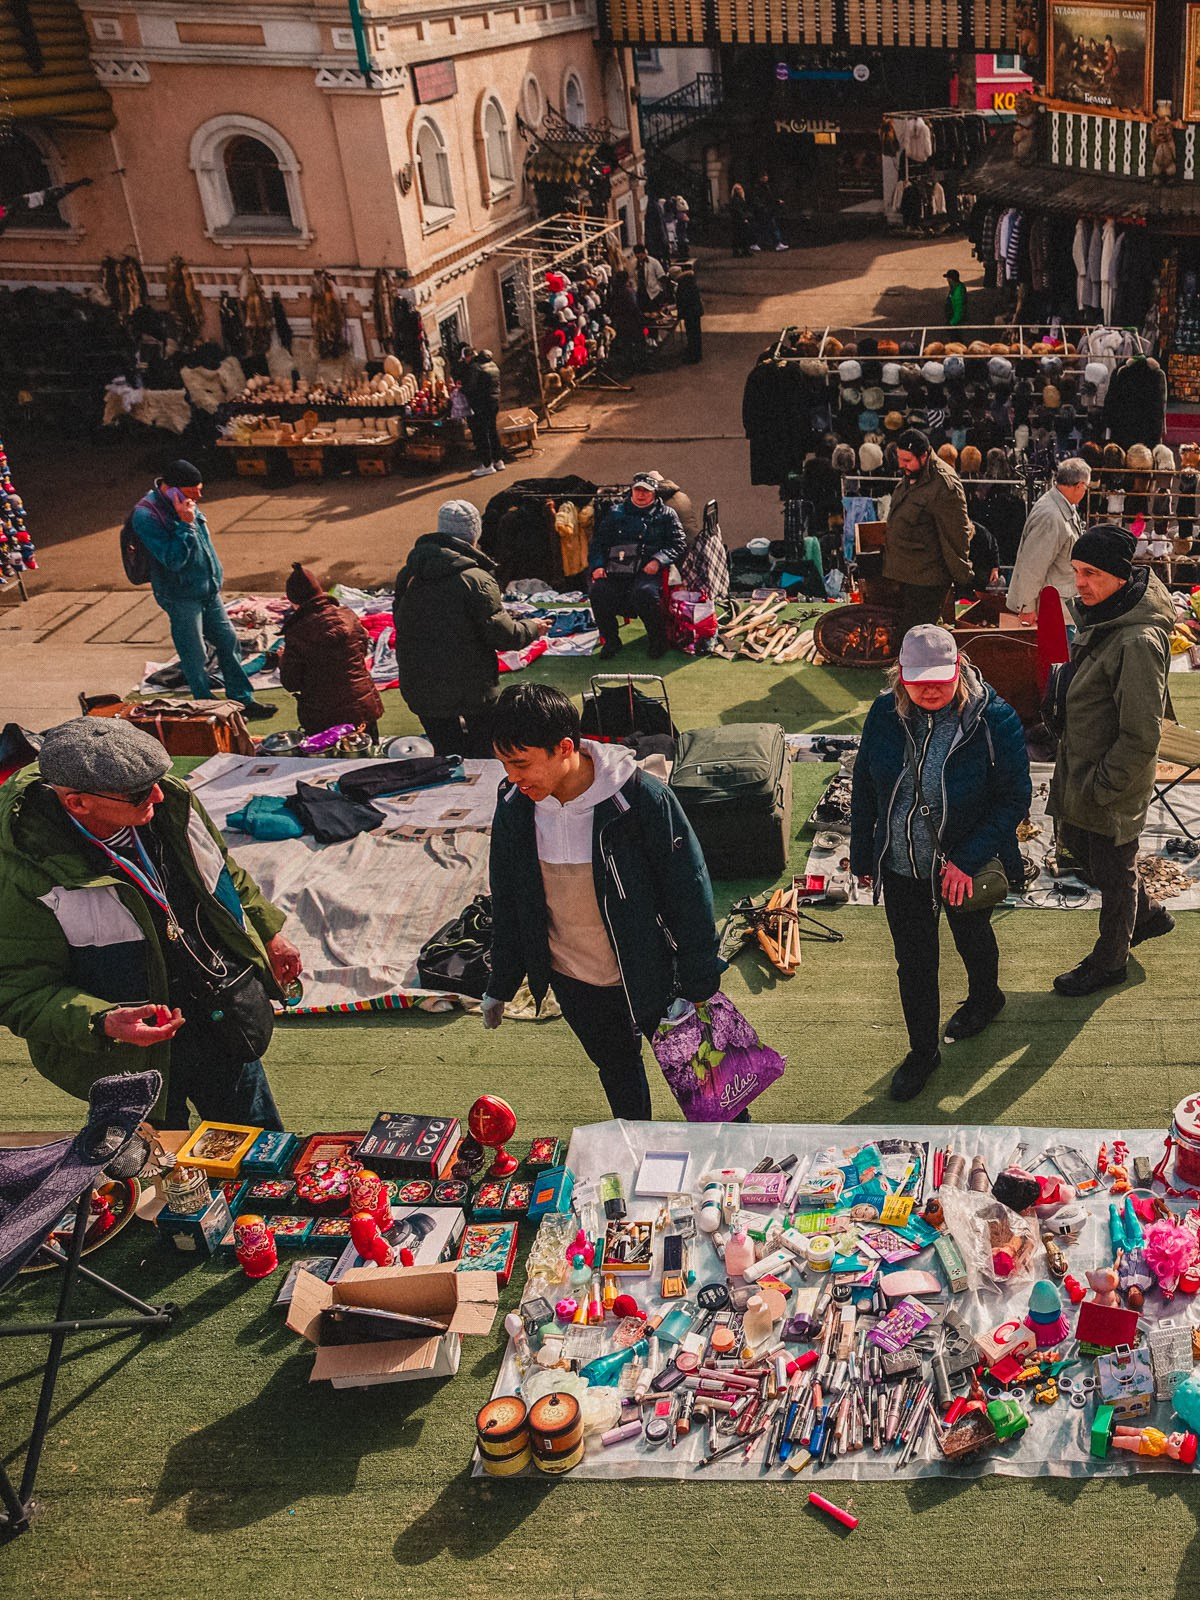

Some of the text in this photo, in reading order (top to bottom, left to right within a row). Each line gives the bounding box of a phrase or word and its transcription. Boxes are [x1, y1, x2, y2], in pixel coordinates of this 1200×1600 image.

[993, 92, 1016, 110] КО
[720, 1072, 758, 1108] Lilac
[808, 1179, 833, 1187] Dove
[883, 1349, 915, 1364] NARS
